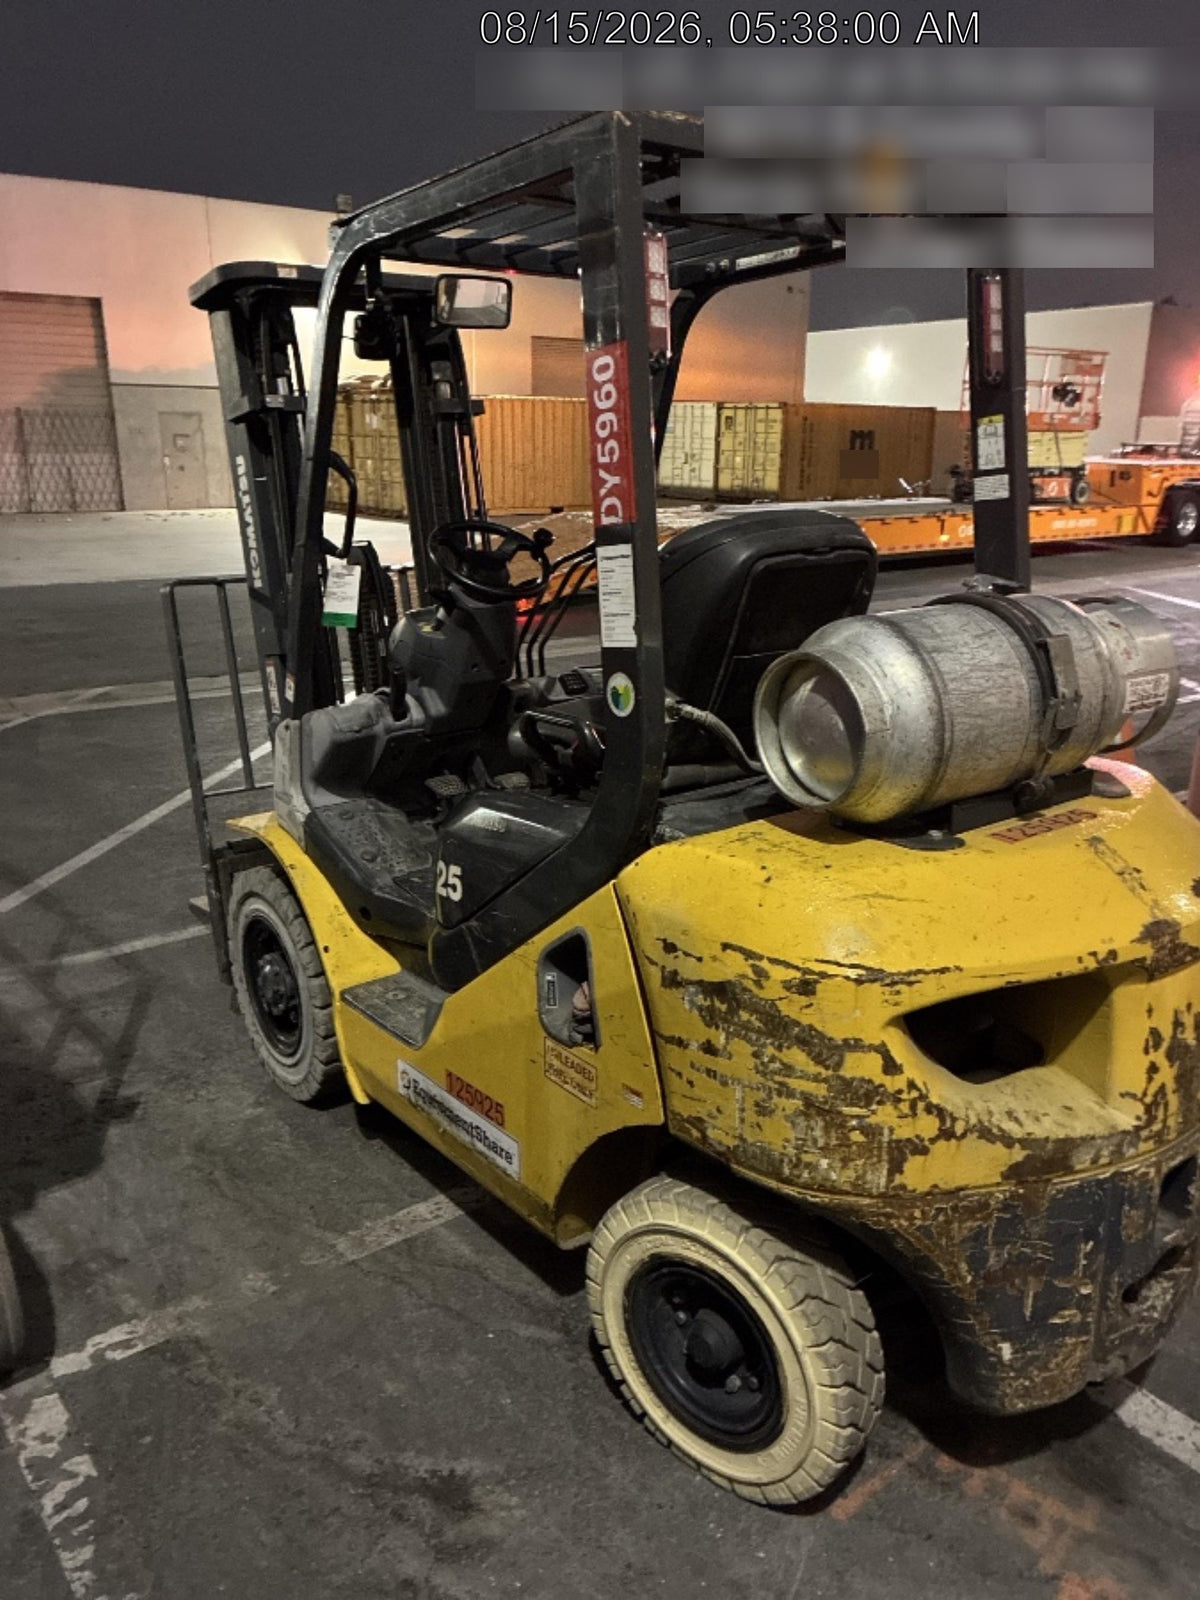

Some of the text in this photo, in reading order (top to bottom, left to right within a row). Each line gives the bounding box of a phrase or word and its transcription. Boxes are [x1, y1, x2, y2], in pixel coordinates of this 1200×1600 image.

[592, 354, 623, 525] DY5960
[235, 454, 263, 589] KOMATSU
[436, 859, 463, 902] 25
[445, 1069, 505, 1127] 125925
